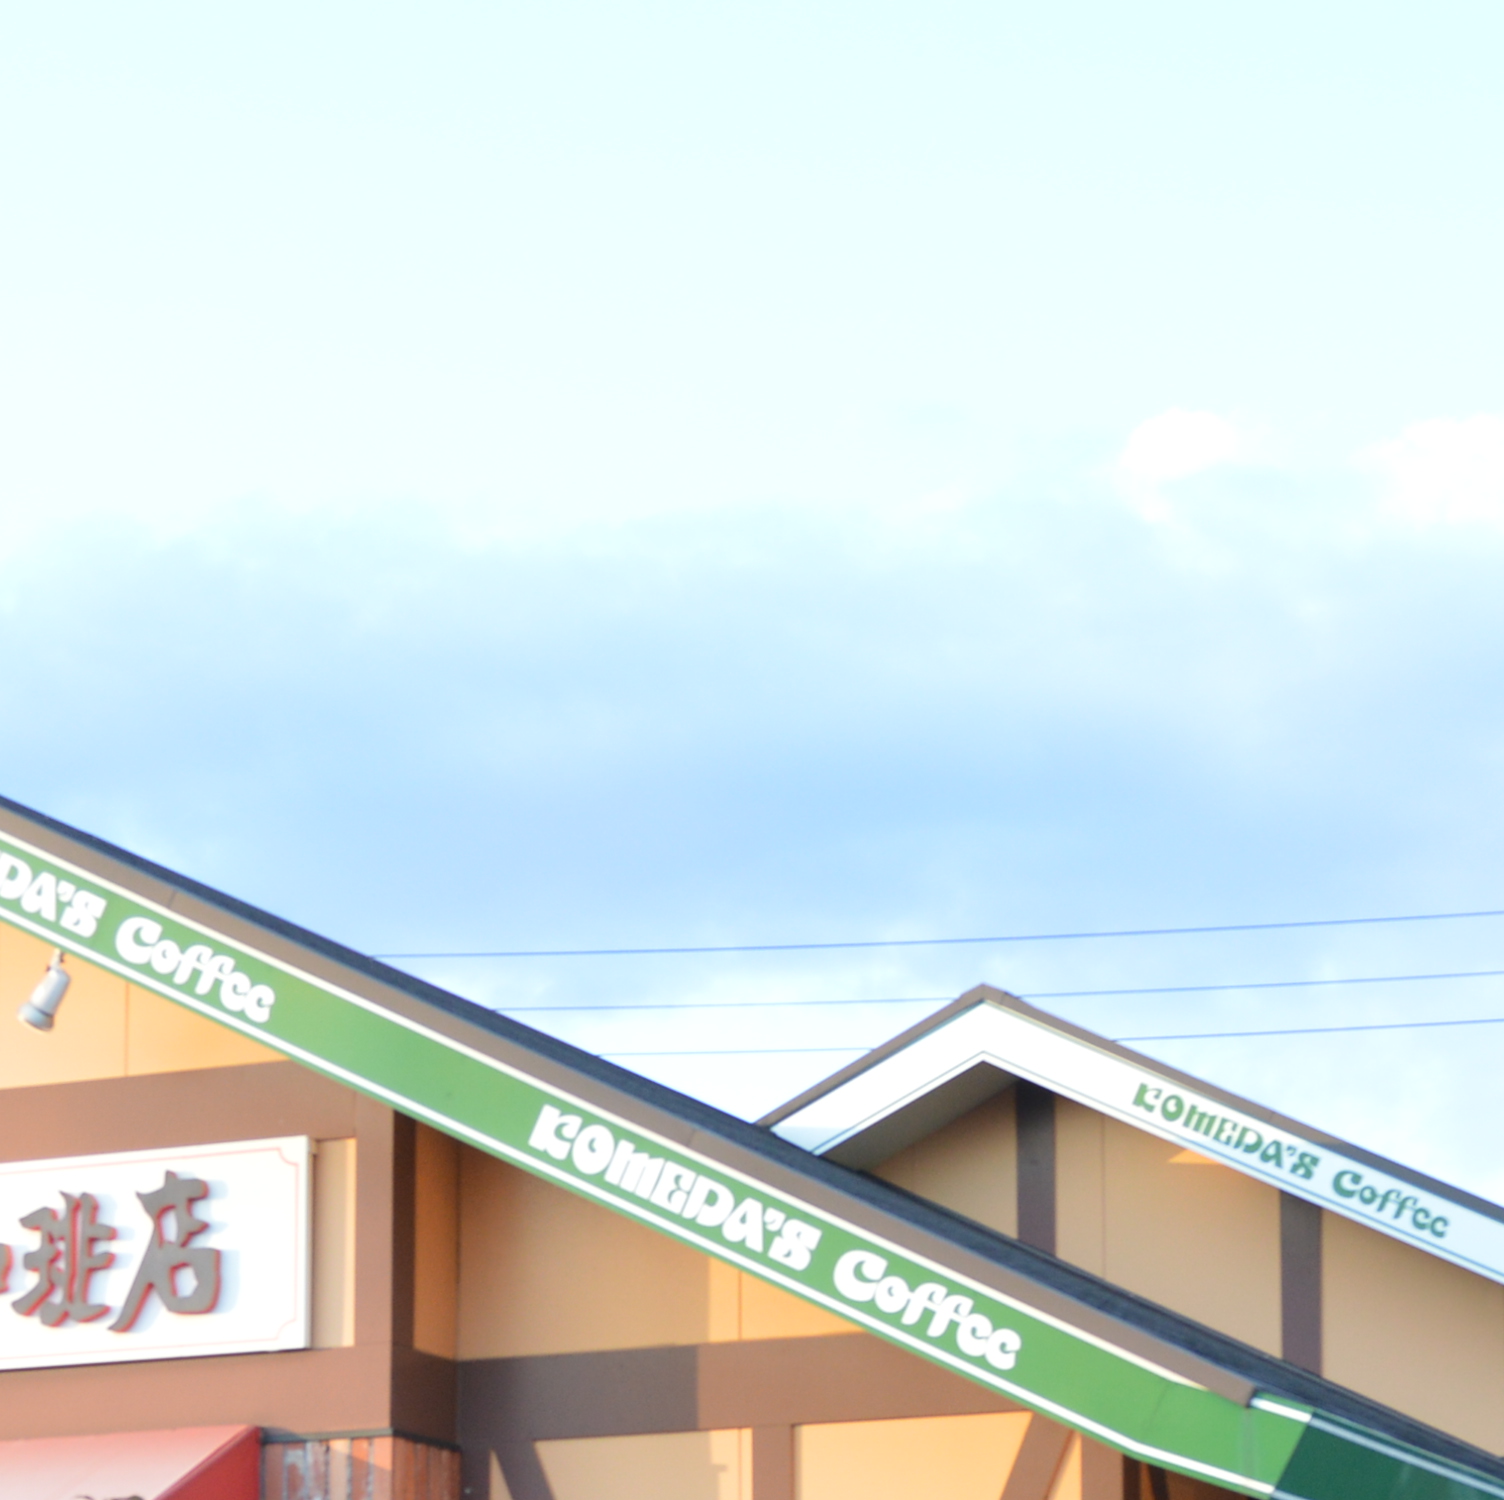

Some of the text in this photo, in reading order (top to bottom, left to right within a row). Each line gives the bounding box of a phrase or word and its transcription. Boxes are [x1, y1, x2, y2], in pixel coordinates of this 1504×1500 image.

[115, 916, 276, 1023] Coffee
[528, 1104, 1022, 1371] KOMEDA'S Coffee
[1131, 1082, 1450, 1238] KOMEDA'S Coffee
